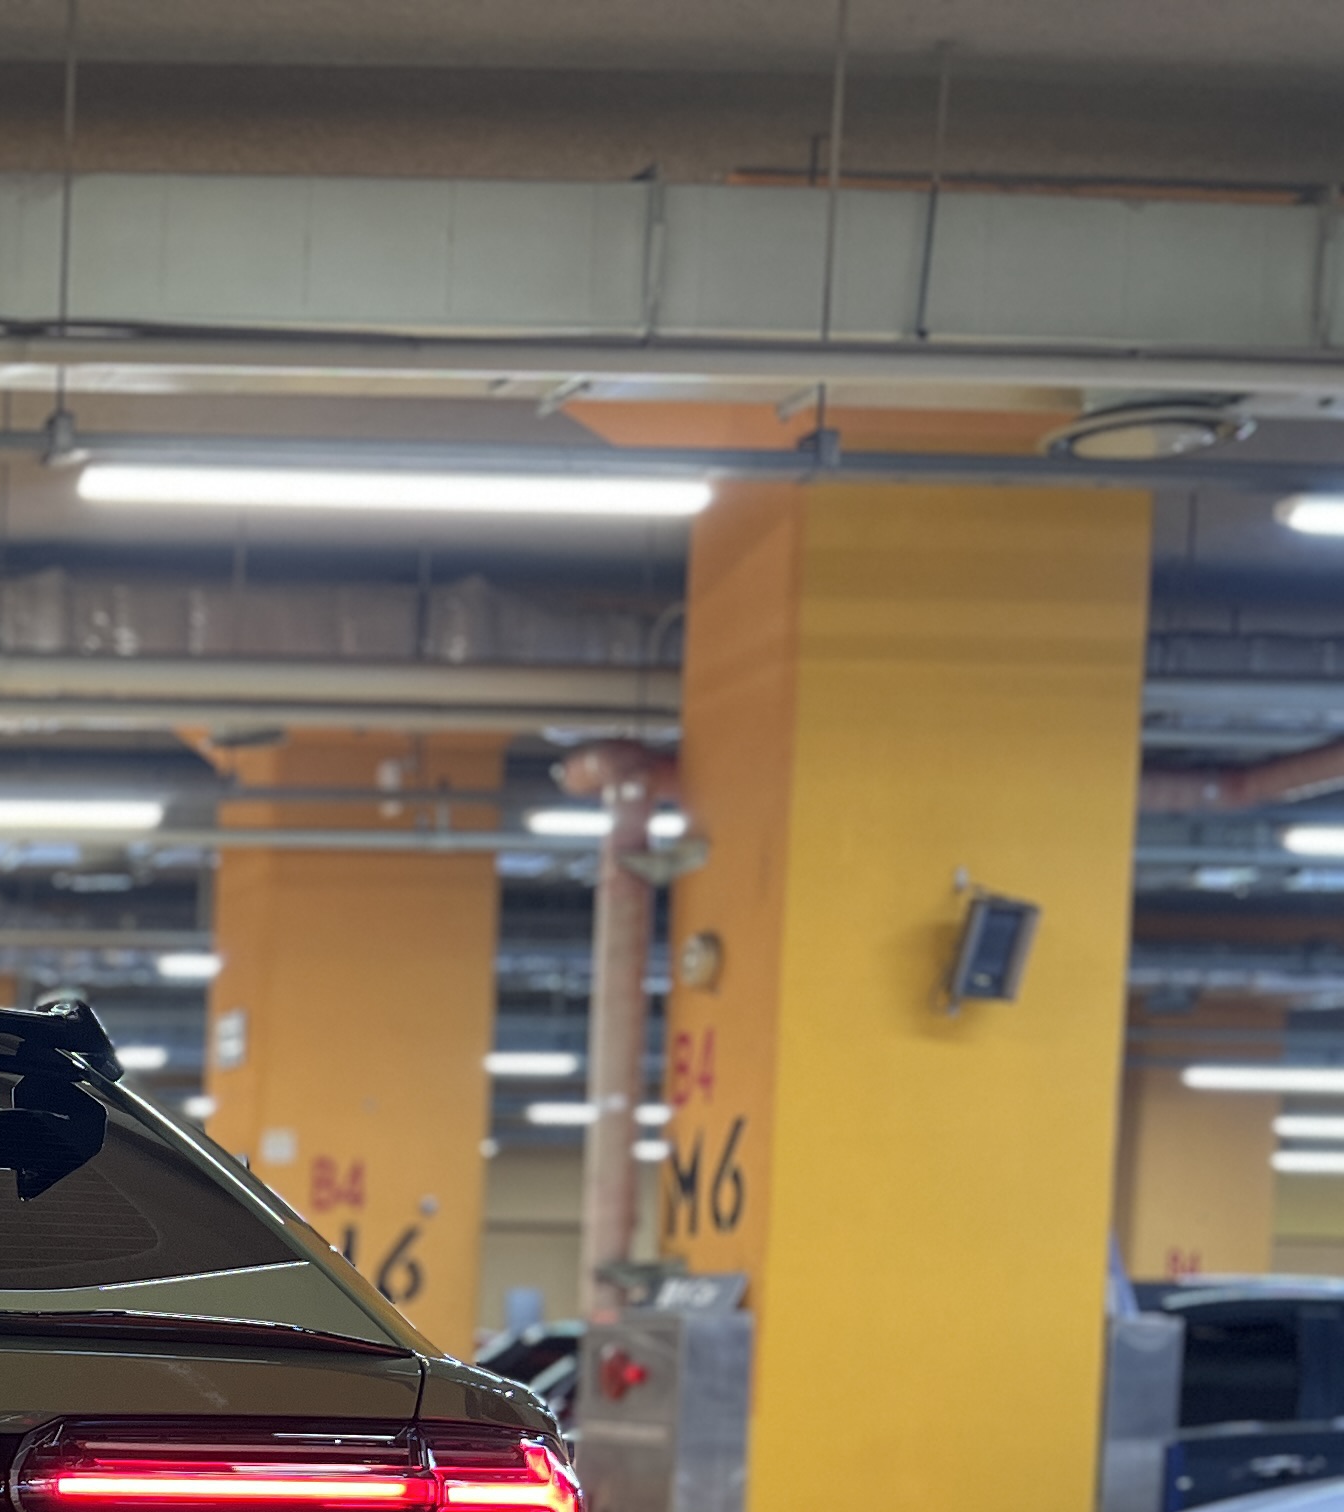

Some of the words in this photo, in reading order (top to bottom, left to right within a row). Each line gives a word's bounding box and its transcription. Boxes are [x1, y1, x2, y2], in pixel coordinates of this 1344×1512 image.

[670, 1026, 715, 1110] B4
[311, 1155, 366, 1212] B4
[665, 1114, 746, 1238] M6
